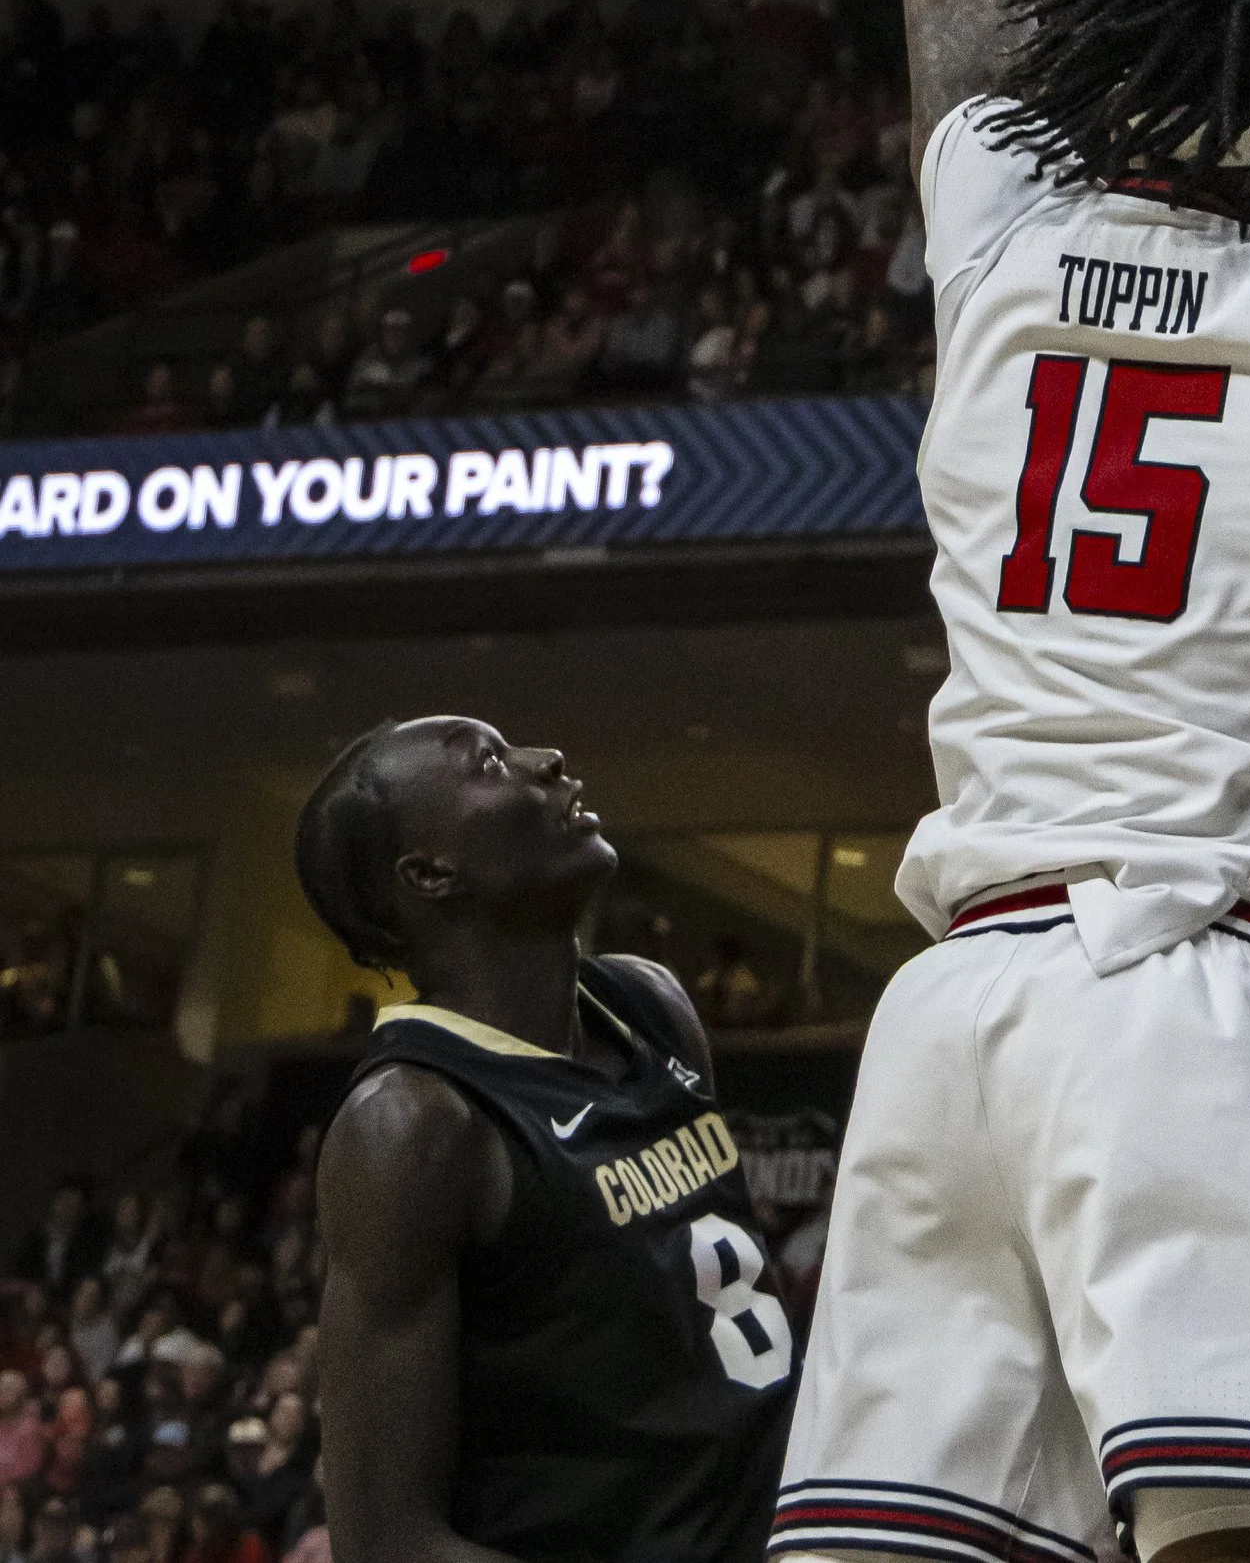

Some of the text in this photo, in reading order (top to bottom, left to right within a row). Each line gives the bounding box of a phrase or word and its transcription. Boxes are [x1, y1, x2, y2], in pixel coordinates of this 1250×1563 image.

[1058, 254, 1209, 335] TOPPIN
[0, 441, 674, 537] ARD ON YOUR PAINT?
[996, 353, 1232, 625] 15
[689, 1212, 793, 1390] 8
